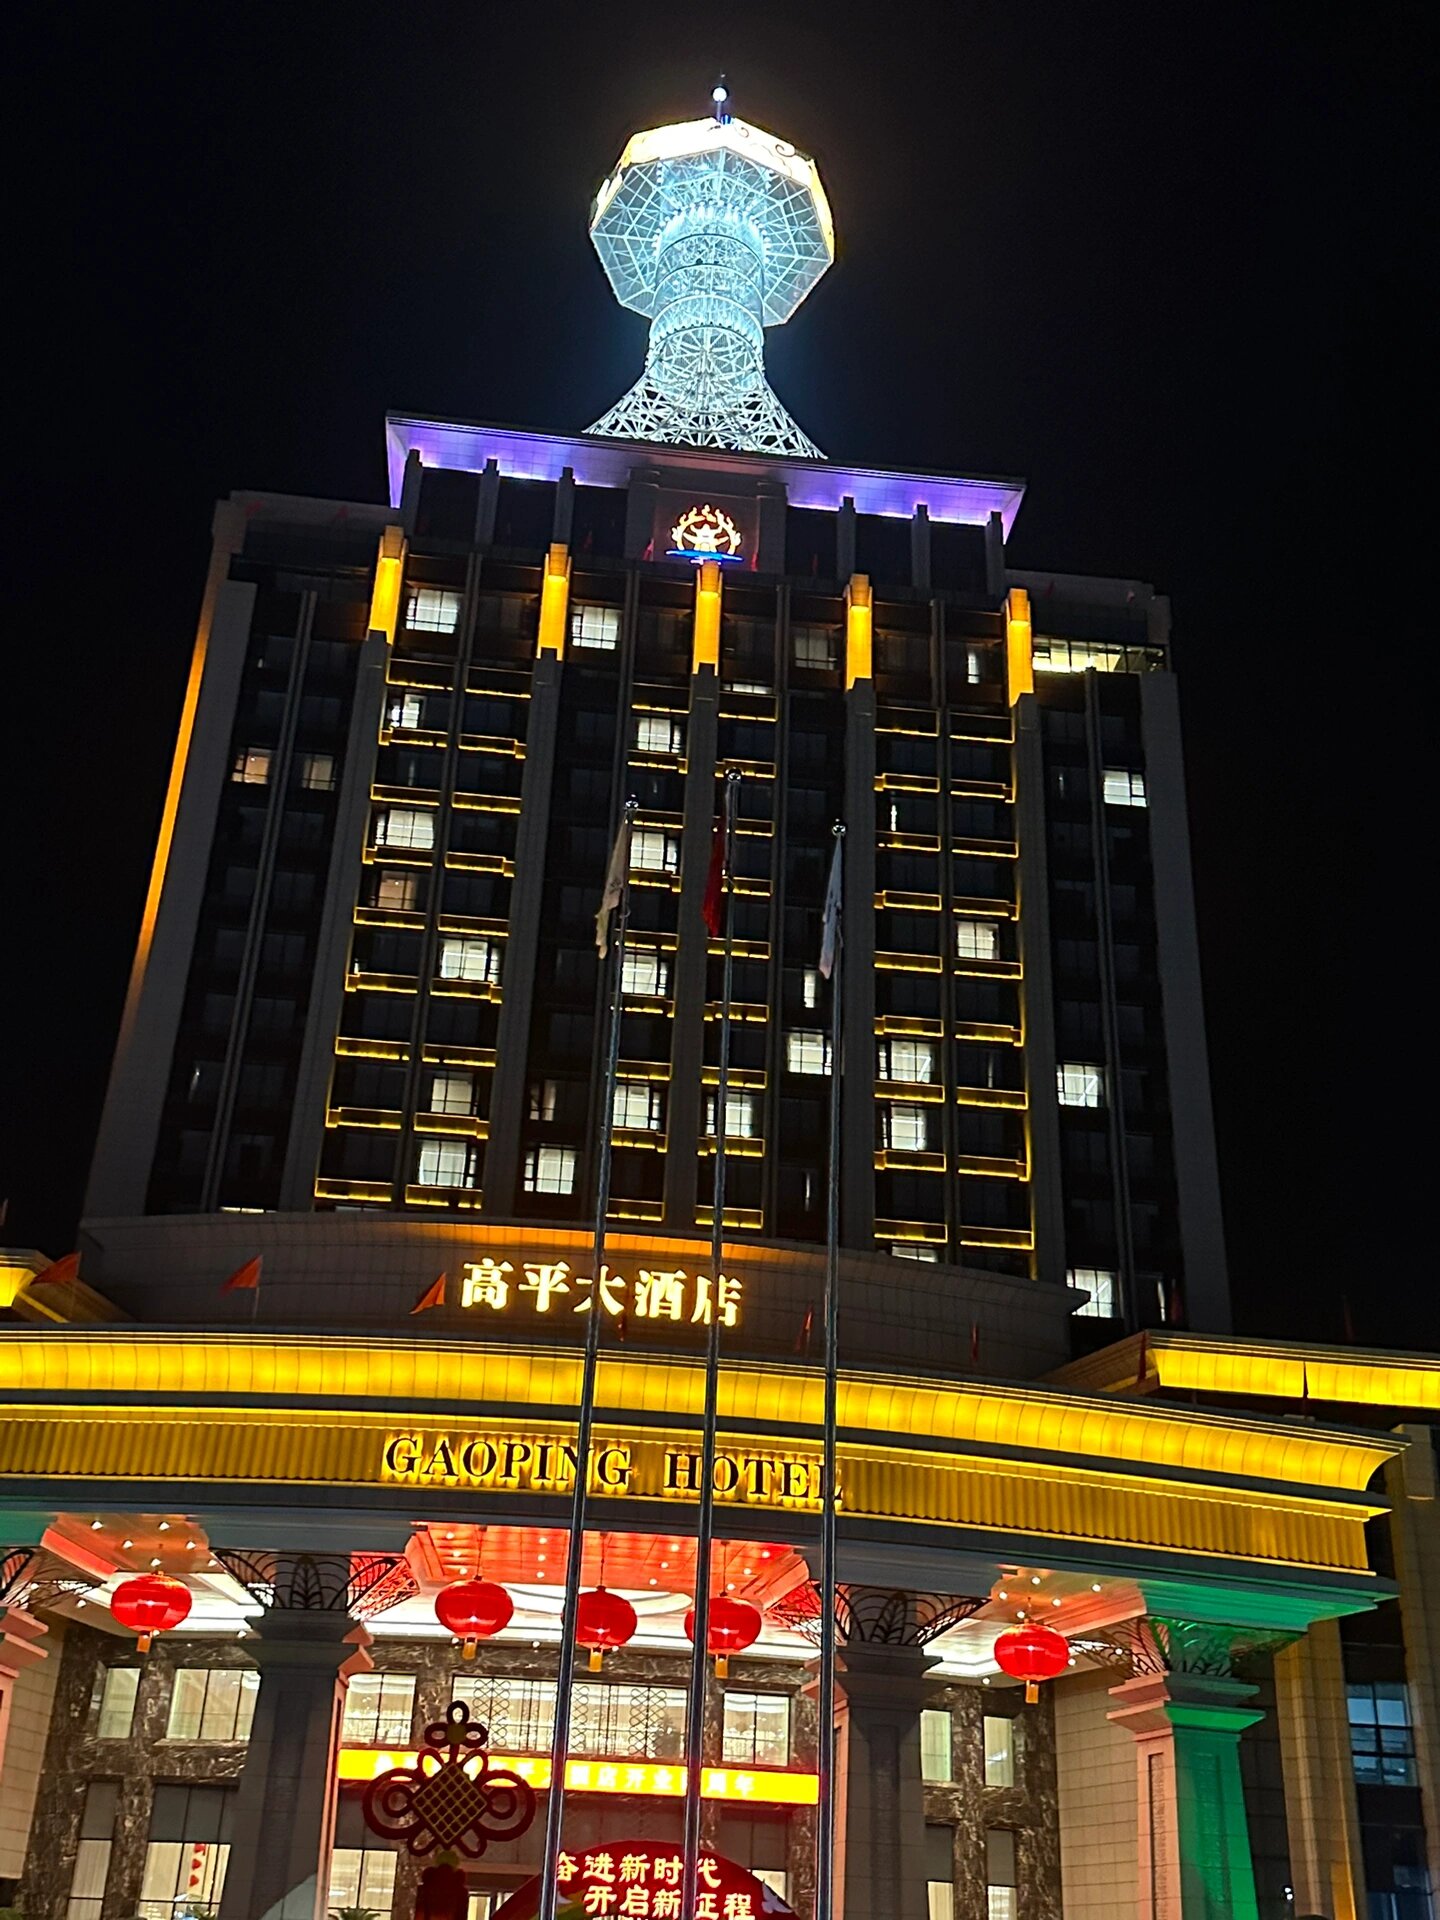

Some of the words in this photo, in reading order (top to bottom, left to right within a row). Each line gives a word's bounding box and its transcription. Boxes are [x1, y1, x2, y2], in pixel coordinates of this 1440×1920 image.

[460, 1257, 744, 1328] 高平大酒店
[385, 1436, 633, 1486] GAOPING
